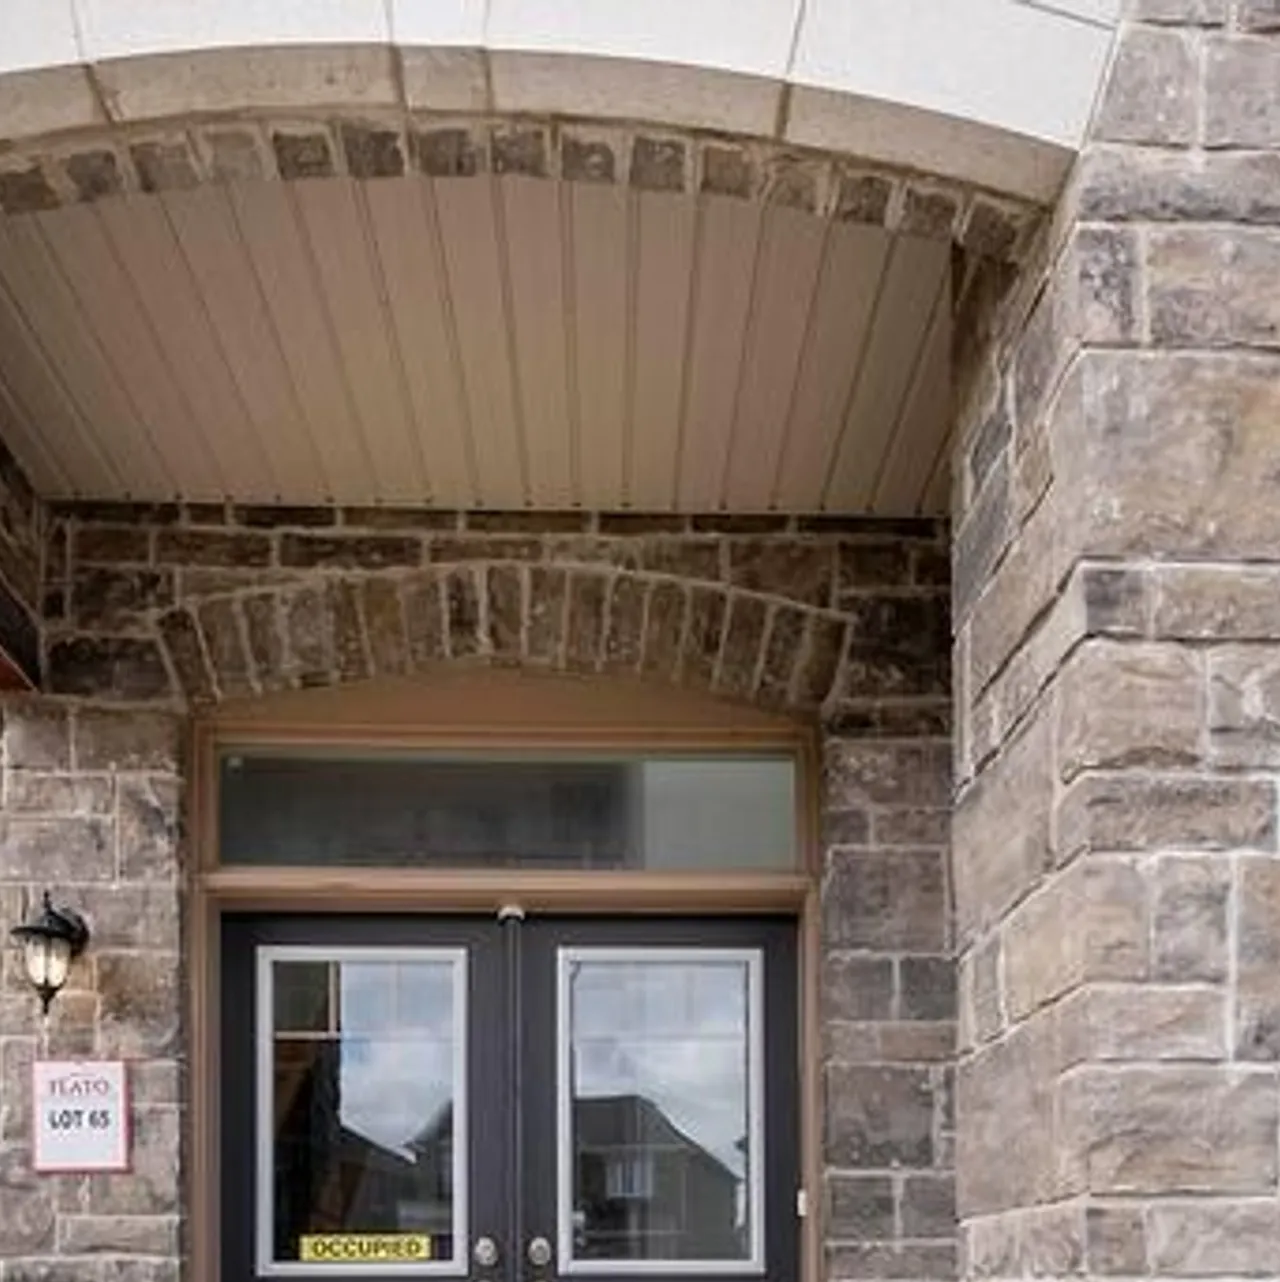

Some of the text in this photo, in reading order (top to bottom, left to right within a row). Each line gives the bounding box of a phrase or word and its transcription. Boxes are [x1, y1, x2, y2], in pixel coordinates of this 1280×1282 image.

[48, 1108, 111, 1130] LOT 65
[311, 1239, 423, 1258] OCCUPIED
